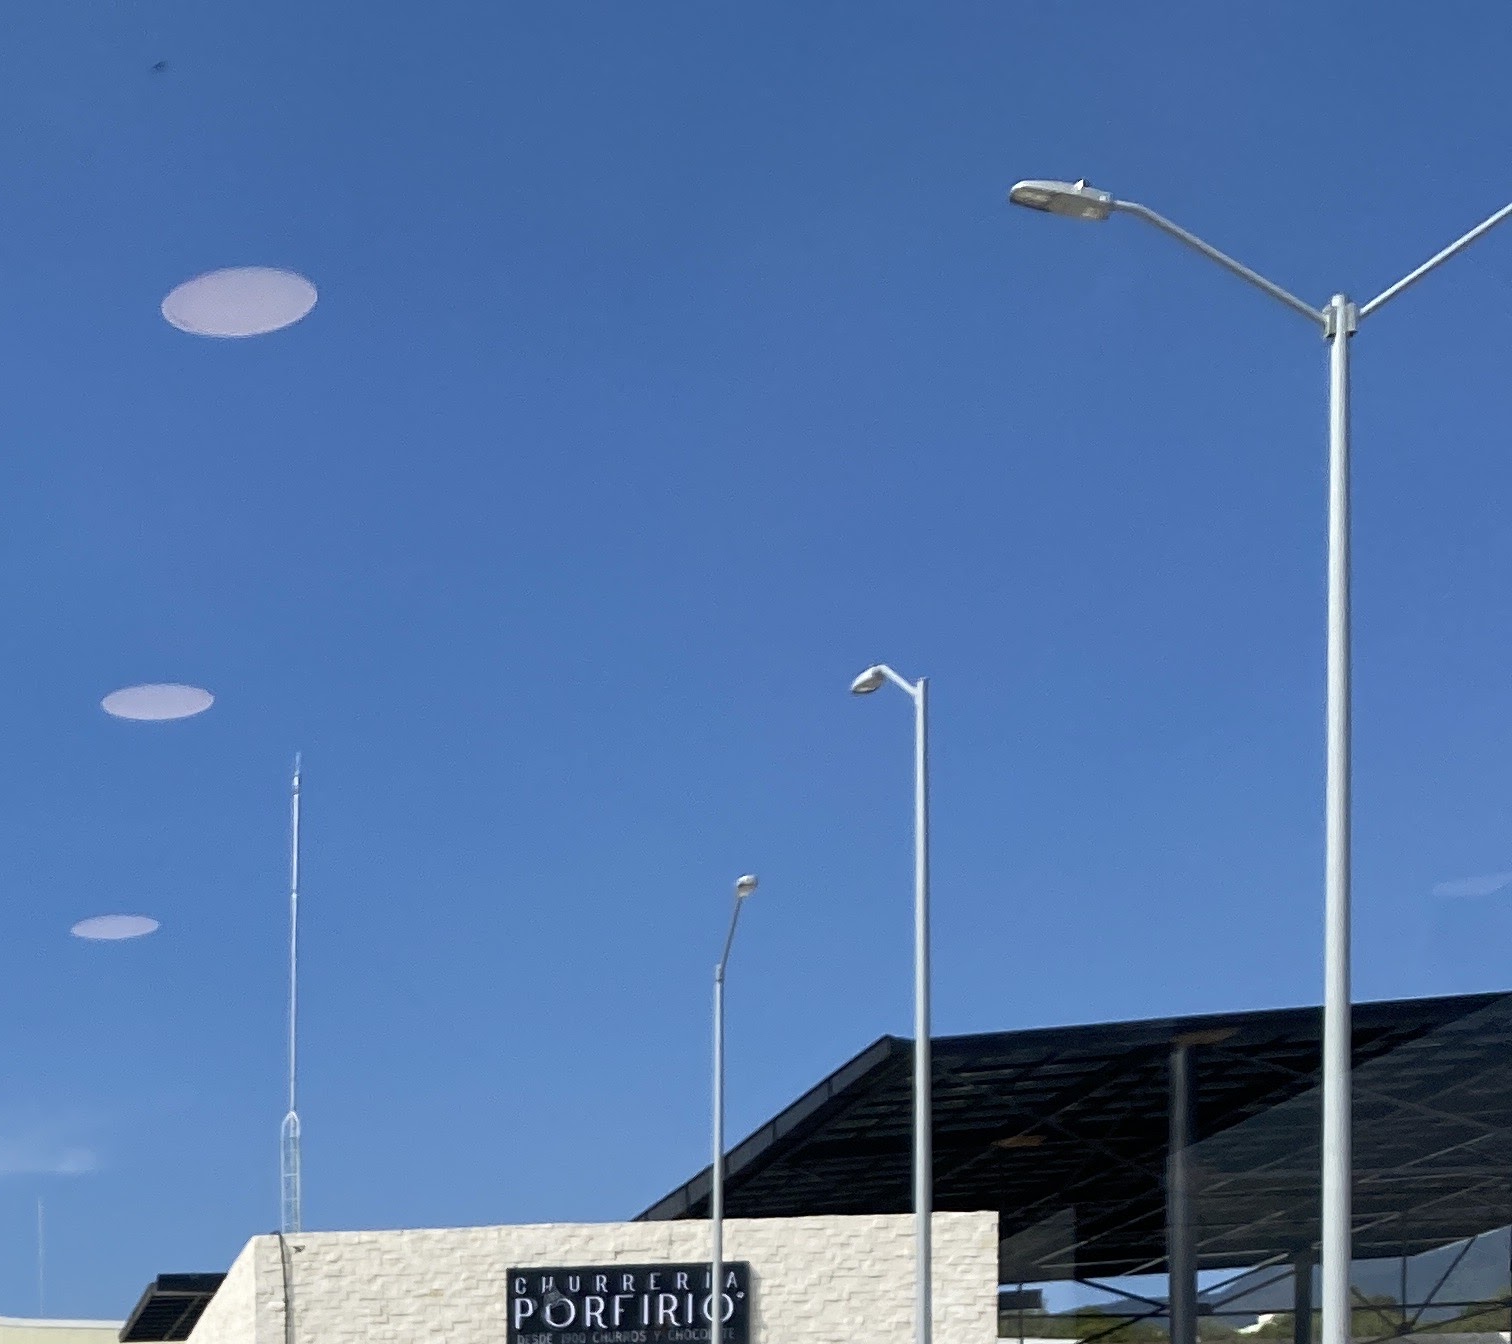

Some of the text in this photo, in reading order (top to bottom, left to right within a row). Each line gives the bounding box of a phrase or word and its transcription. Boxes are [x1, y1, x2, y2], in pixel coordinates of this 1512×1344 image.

[514, 1293, 734, 1330] PORFIRIO
[561, 1332, 586, 1344] 1900
[592, 1329, 647, 1344] CHURROS
[654, 1330, 663, 1342] Y
[668, 1327, 736, 1342] CHOCOLTE
